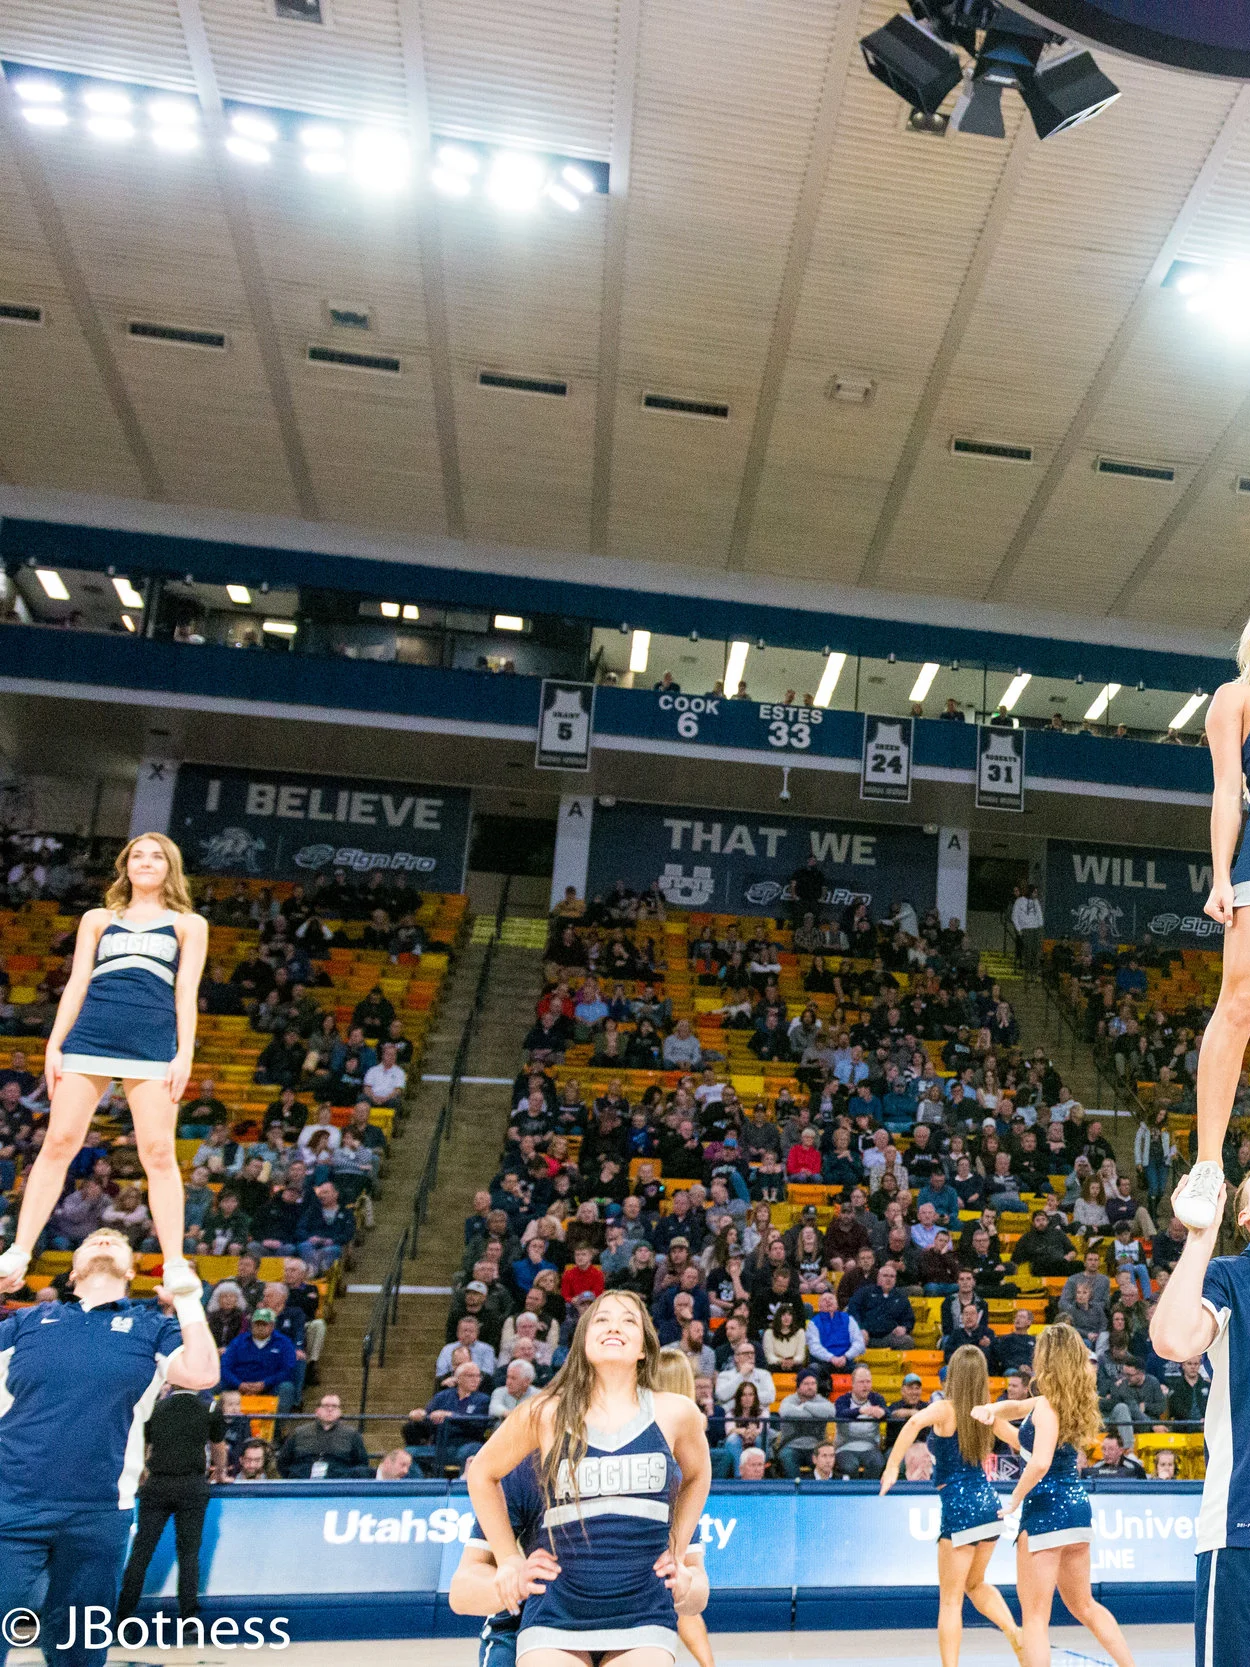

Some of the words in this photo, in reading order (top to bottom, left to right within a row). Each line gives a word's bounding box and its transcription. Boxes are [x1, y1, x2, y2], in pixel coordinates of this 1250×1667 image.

[658, 695, 720, 715] COOK
[759, 704, 824, 724] ESTES
[557, 722, 572, 741] 5
[677, 712, 699, 738] 6
[767, 721, 811, 749] 33
[149, 763, 165, 781] X
[871, 753, 902, 775] 24
[987, 764, 1013, 783] 31
[205, 780, 221, 812] I
[245, 783, 444, 830] BELIEVE
[567, 800, 584, 819] A
[663, 818, 787, 858] THAT
[810, 831, 877, 866] WE
[947, 833, 962, 852] A
[390, 852, 437, 872] Pro
[1072, 854, 1167, 890] WILL
[555, 1452, 667, 1500] AGGIES
